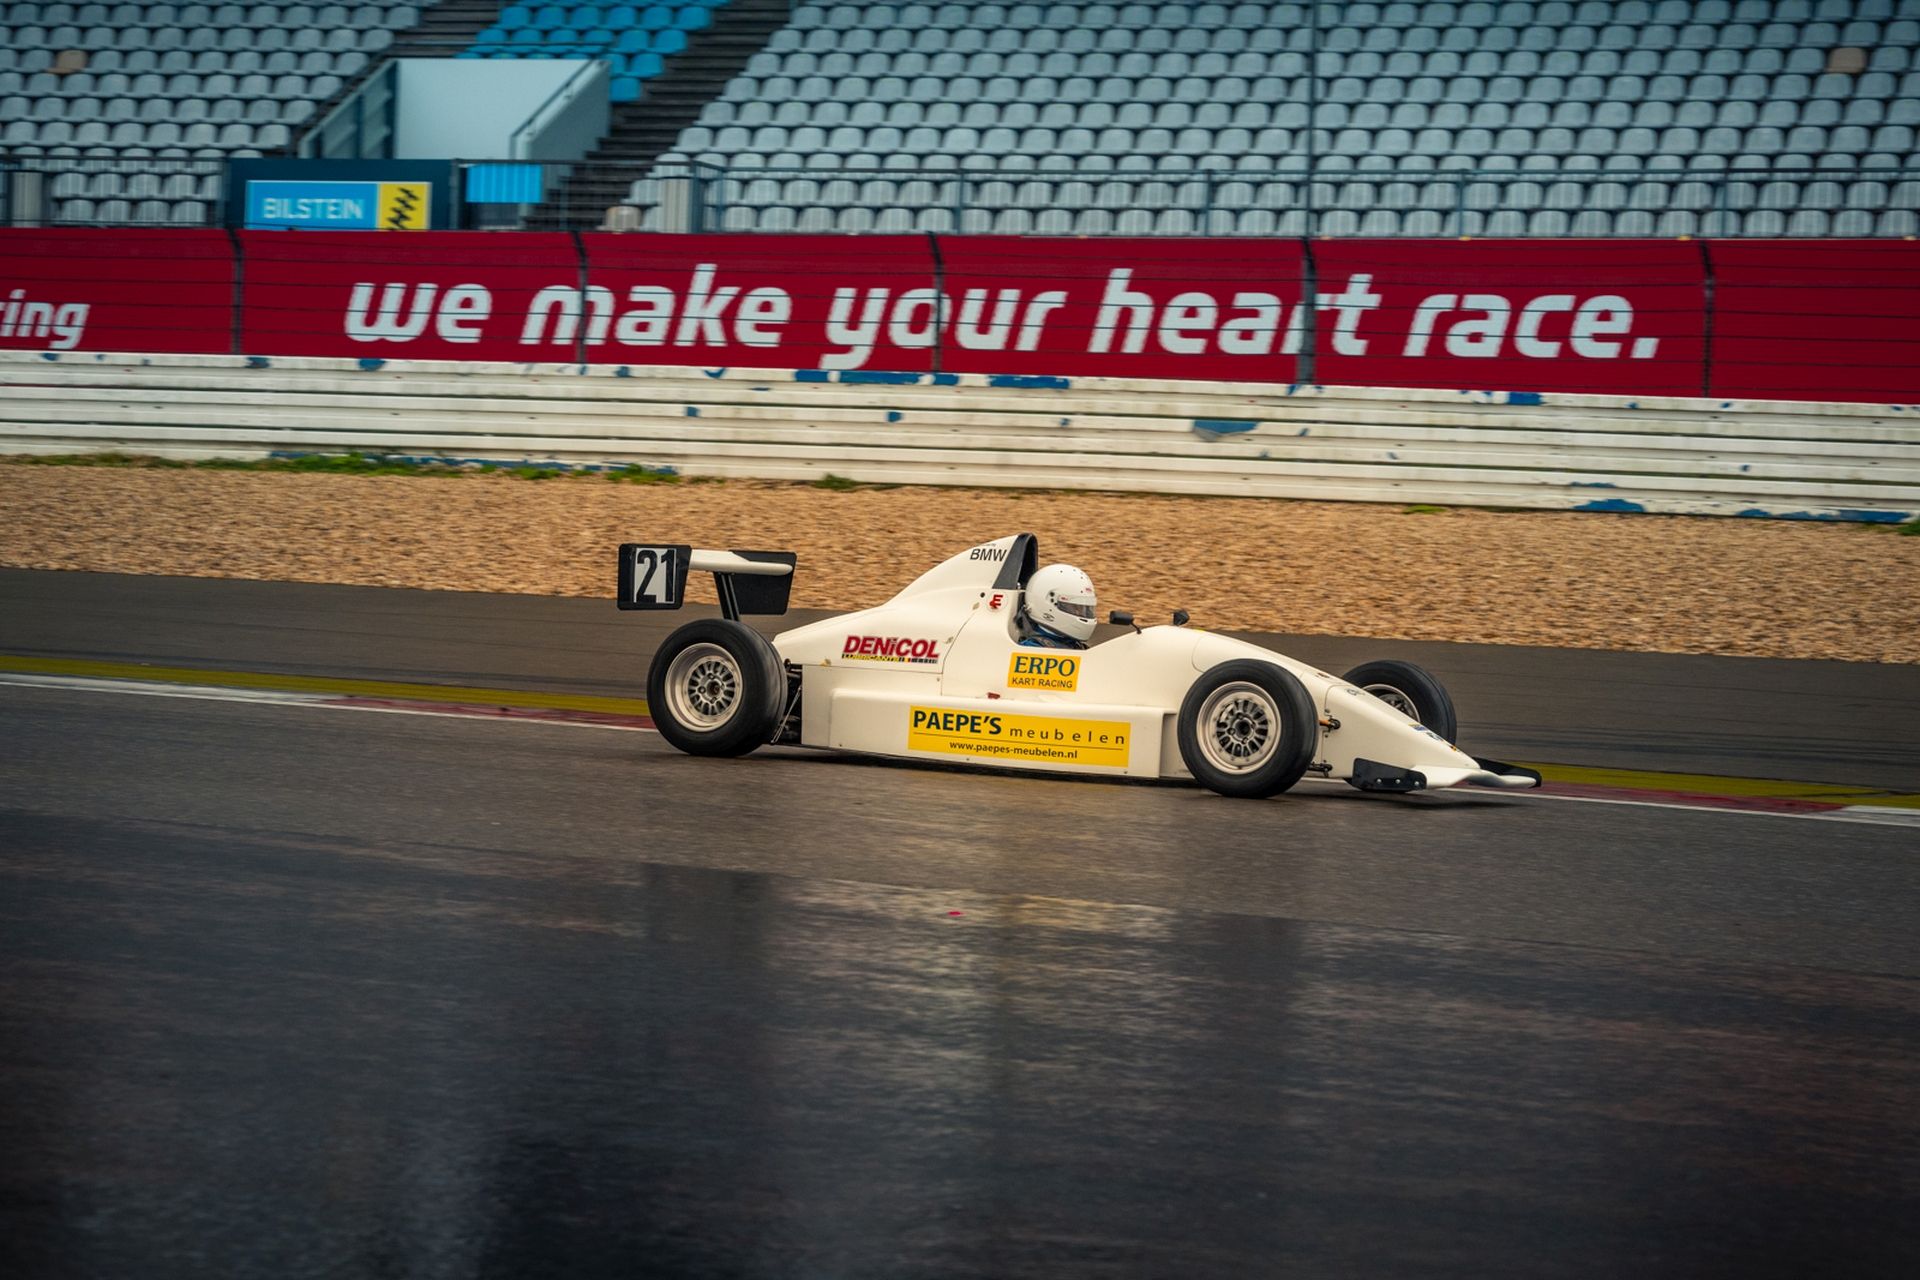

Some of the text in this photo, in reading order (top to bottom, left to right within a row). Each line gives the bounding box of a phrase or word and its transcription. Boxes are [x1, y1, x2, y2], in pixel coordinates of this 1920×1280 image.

[263, 198, 363, 220] BILSTEIN
[344, 263, 1660, 370] we make your heart race.
[970, 548, 1007, 562] BMW
[636, 549, 675, 602] 21
[1014, 656, 1076, 677] ERPO
[1011, 677, 1073, 689] KART RACING
[913, 710, 1125, 745] PAEPE'S meubelen
[949, 741, 1078, 759] www.paepes-meubelen.nl
